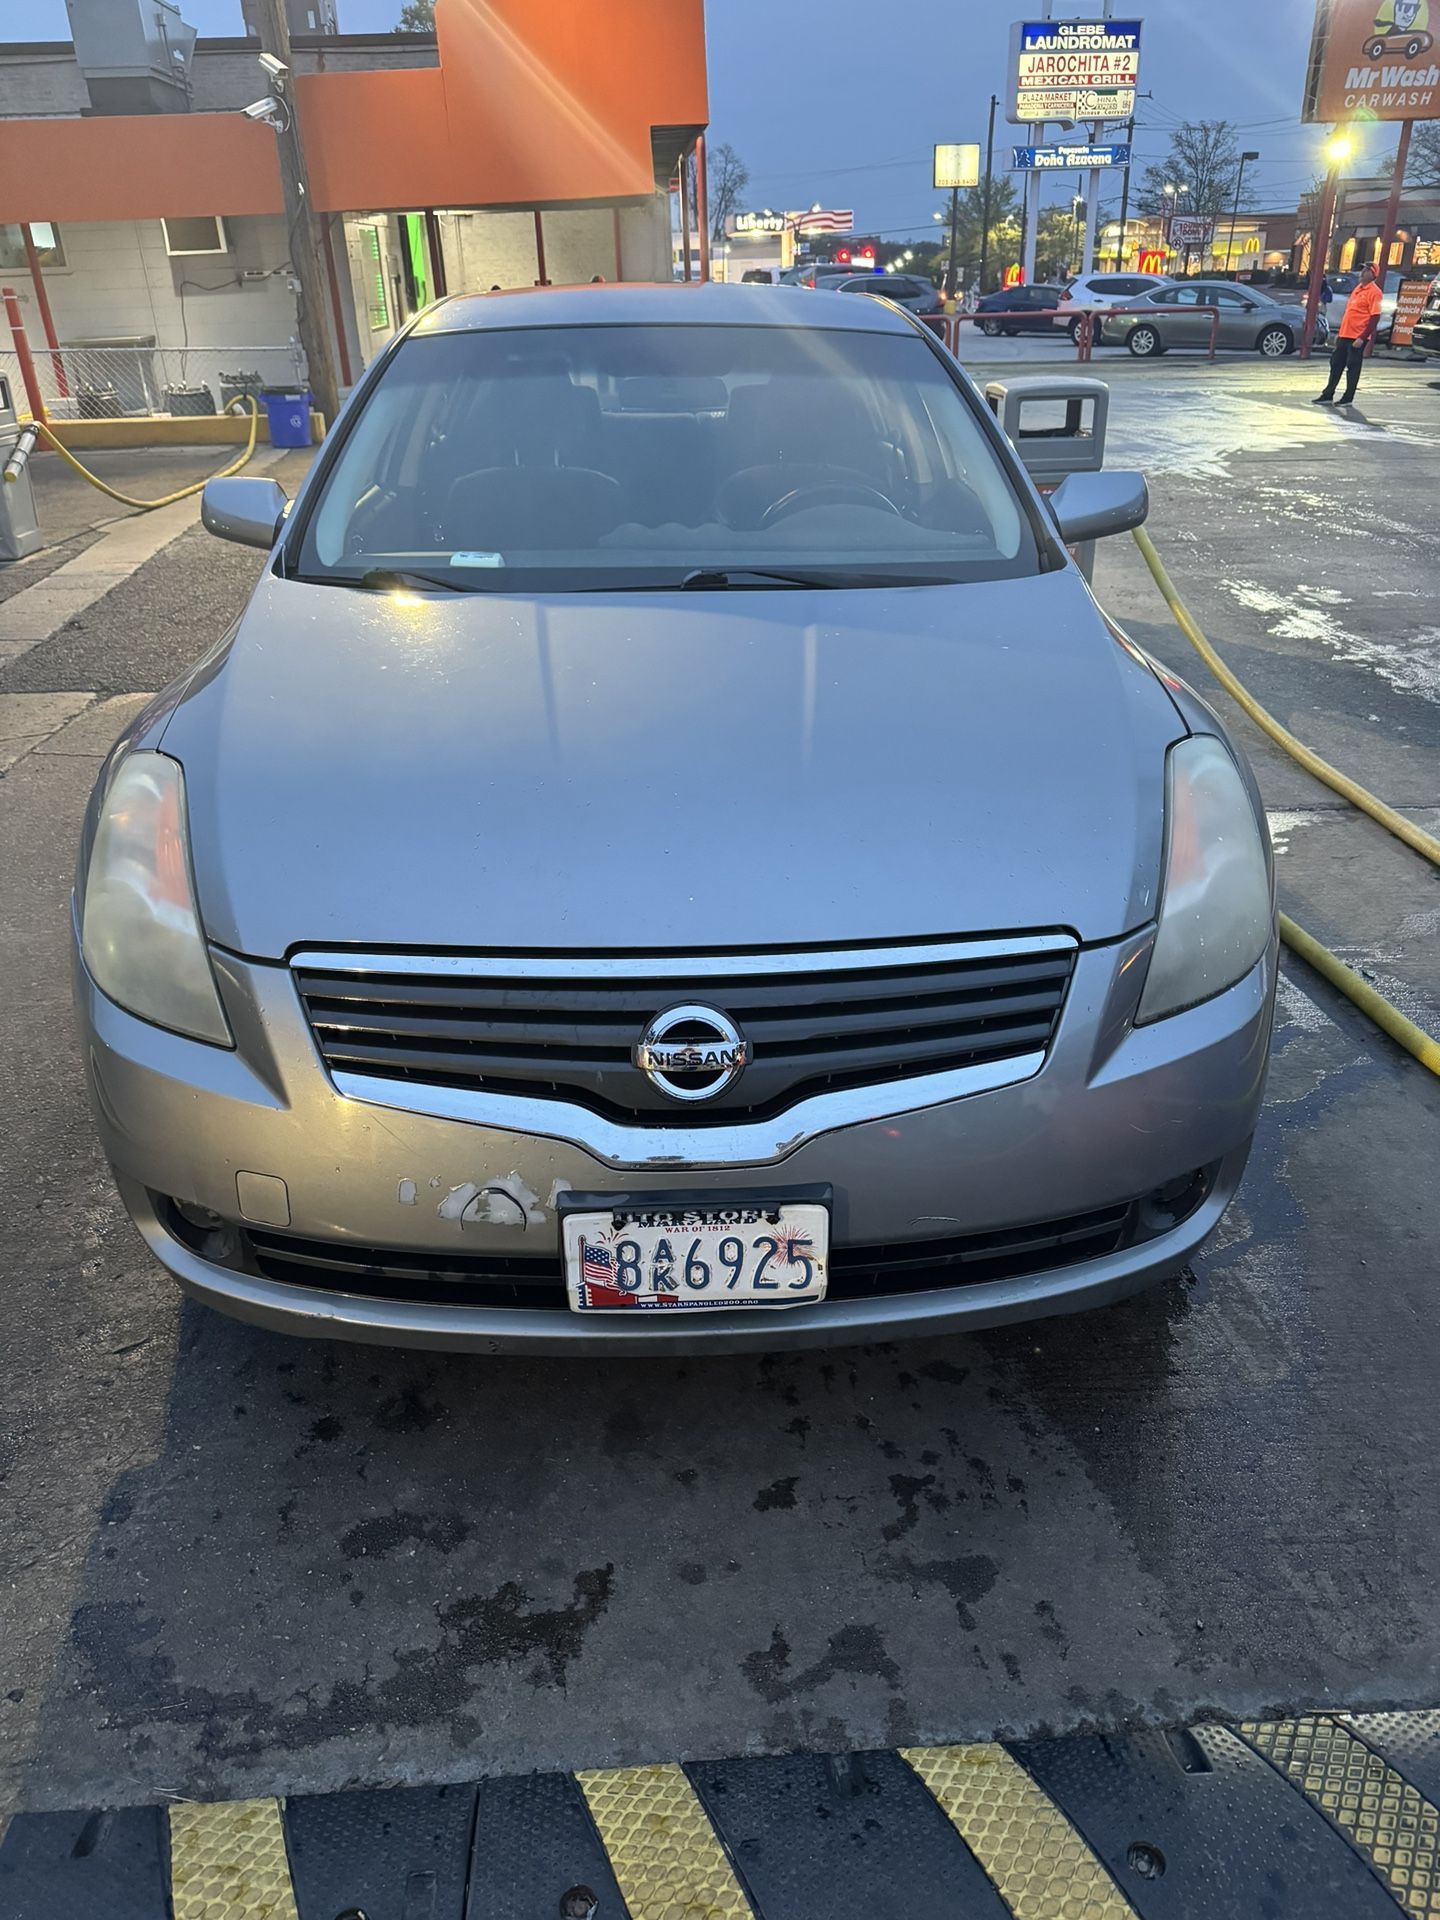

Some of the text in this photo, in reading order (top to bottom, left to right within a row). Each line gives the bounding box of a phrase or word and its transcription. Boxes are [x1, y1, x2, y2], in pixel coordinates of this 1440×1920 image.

[1058, 25, 1106, 36] GLEBE
[1025, 35, 1136, 50] LAUNDROMAT
[1028, 54, 1131, 73] JAROCHITA #2
[1020, 74, 1134, 87] MEXICAN GRILL
[1022, 92, 1072, 102] PLAZA MARKET
[1344, 91, 1433, 108] CARWASH
[1035, 154, 1064, 167] Doña
[736, 212, 785, 231] Liberty
[648, 1049, 737, 1067] NISSAN
[691, 1225, 705, 1233] OF
